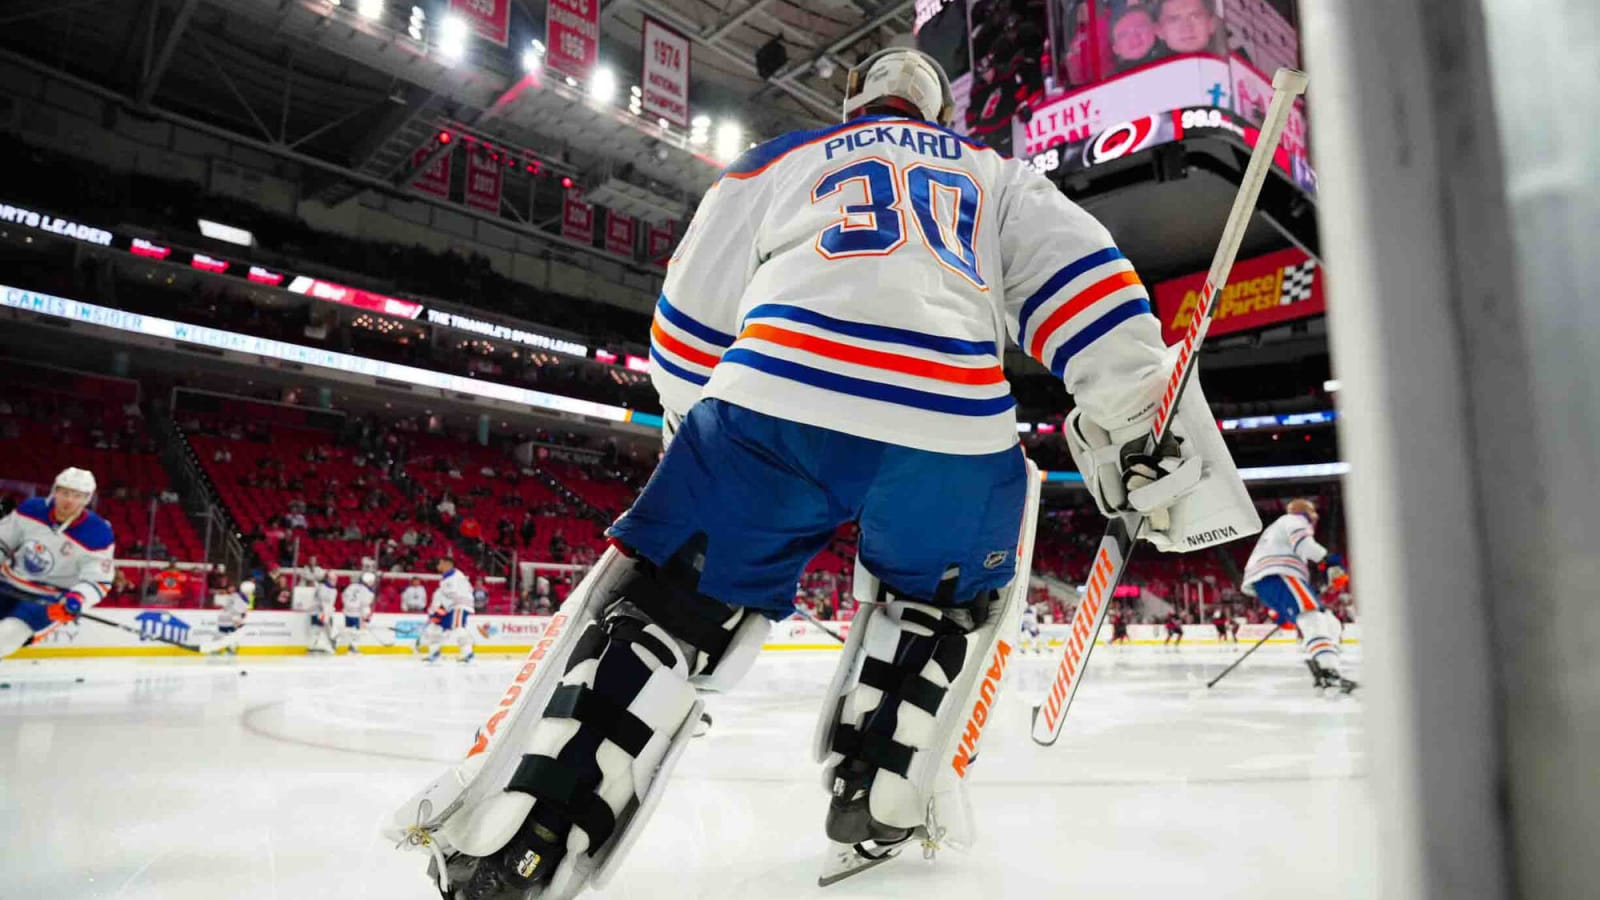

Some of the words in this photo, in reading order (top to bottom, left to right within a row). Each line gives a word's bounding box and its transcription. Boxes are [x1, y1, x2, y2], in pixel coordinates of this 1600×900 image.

[654, 40, 681, 71] 1974
[824, 127, 961, 160] PICKARD
[0, 203, 40, 228] RTS
[40, 215, 113, 247] LEADER
[811, 156, 990, 292] 30
[6, 287, 66, 317] CANES
[428, 308, 450, 327] THE
[512, 329, 551, 350] SPORTS
[1186, 525, 1239, 548] VAUGHN
[502, 622, 539, 635] Harris
[1044, 547, 1115, 733] WARRIOR
[466, 614, 568, 759] VAUGHN
[951, 639, 1012, 778] VAUGHN
